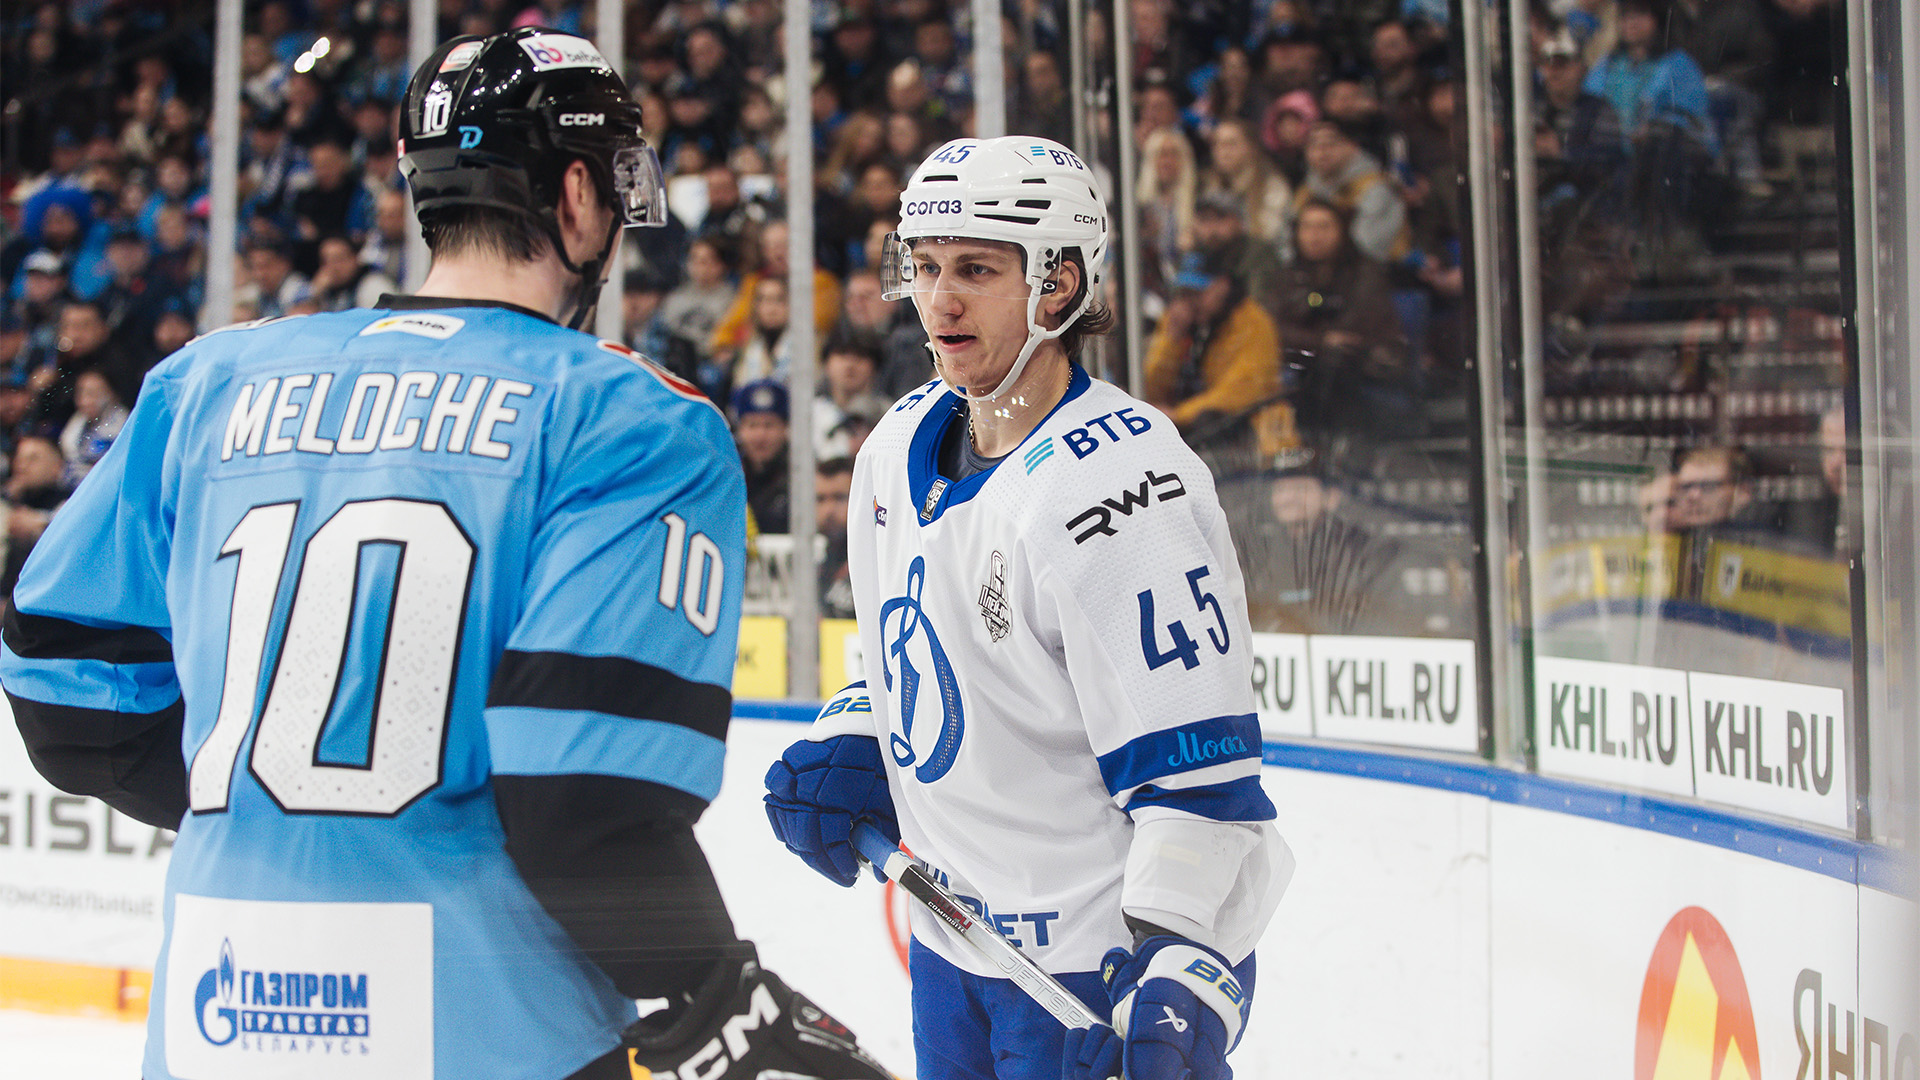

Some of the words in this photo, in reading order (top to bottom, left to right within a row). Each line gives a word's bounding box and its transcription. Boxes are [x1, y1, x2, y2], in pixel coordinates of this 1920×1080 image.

[423, 90, 453, 134] 10
[559, 112, 605, 126] CCM
[932, 144, 977, 164] 45
[1048, 149, 1083, 170] ВТБ
[906, 199, 962, 216] согаз
[1074, 213, 1098, 225] CCM
[221, 371, 534, 462] MELOCHE
[1061, 407, 1152, 460] ВТБ
[658, 511, 724, 637] 10
[1137, 565, 1230, 671] 45
[189, 497, 478, 818] 10
[1327, 659, 1461, 724] KHL.RU
[1550, 681, 1678, 766] KHL.RU
[1704, 700, 1834, 796] KHL.RU
[241, 970, 368, 1008] ГАЗПРОМ
[242, 1012, 368, 1035] ТРАНСГАЗ
[652, 982, 781, 1080] CM
